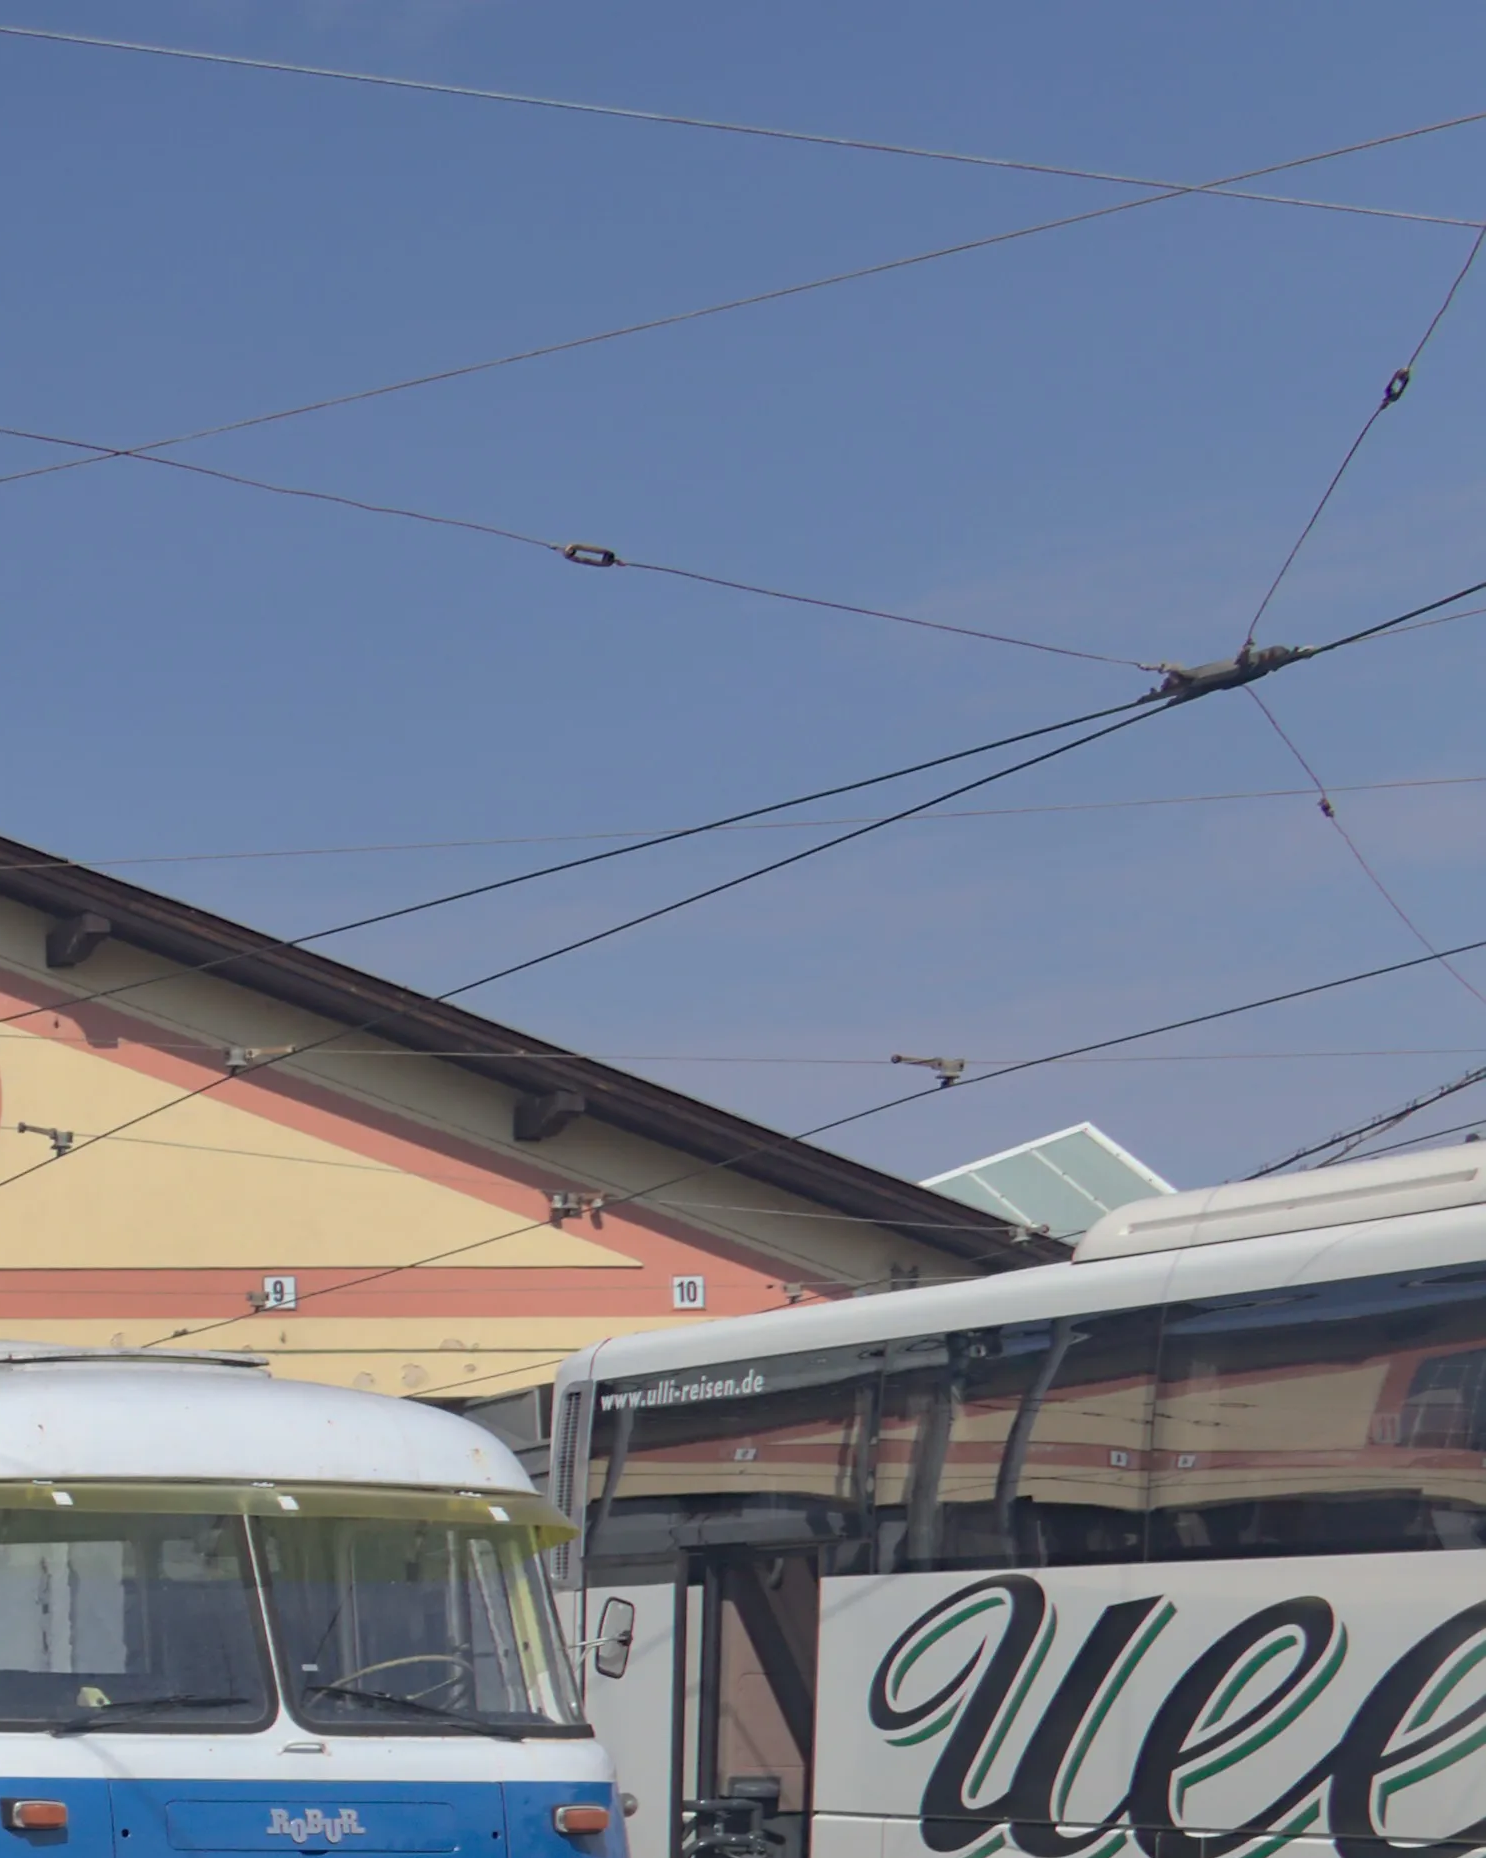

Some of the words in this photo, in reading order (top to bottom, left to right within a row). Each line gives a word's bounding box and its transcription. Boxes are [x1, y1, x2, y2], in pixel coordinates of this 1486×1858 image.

[272, 1280, 285, 1302] 9
[676, 1281, 697, 1302] 10
[601, 1368, 764, 1411] www.ulli-reisen.de
[267, 1808, 366, 1843] ROBUR
